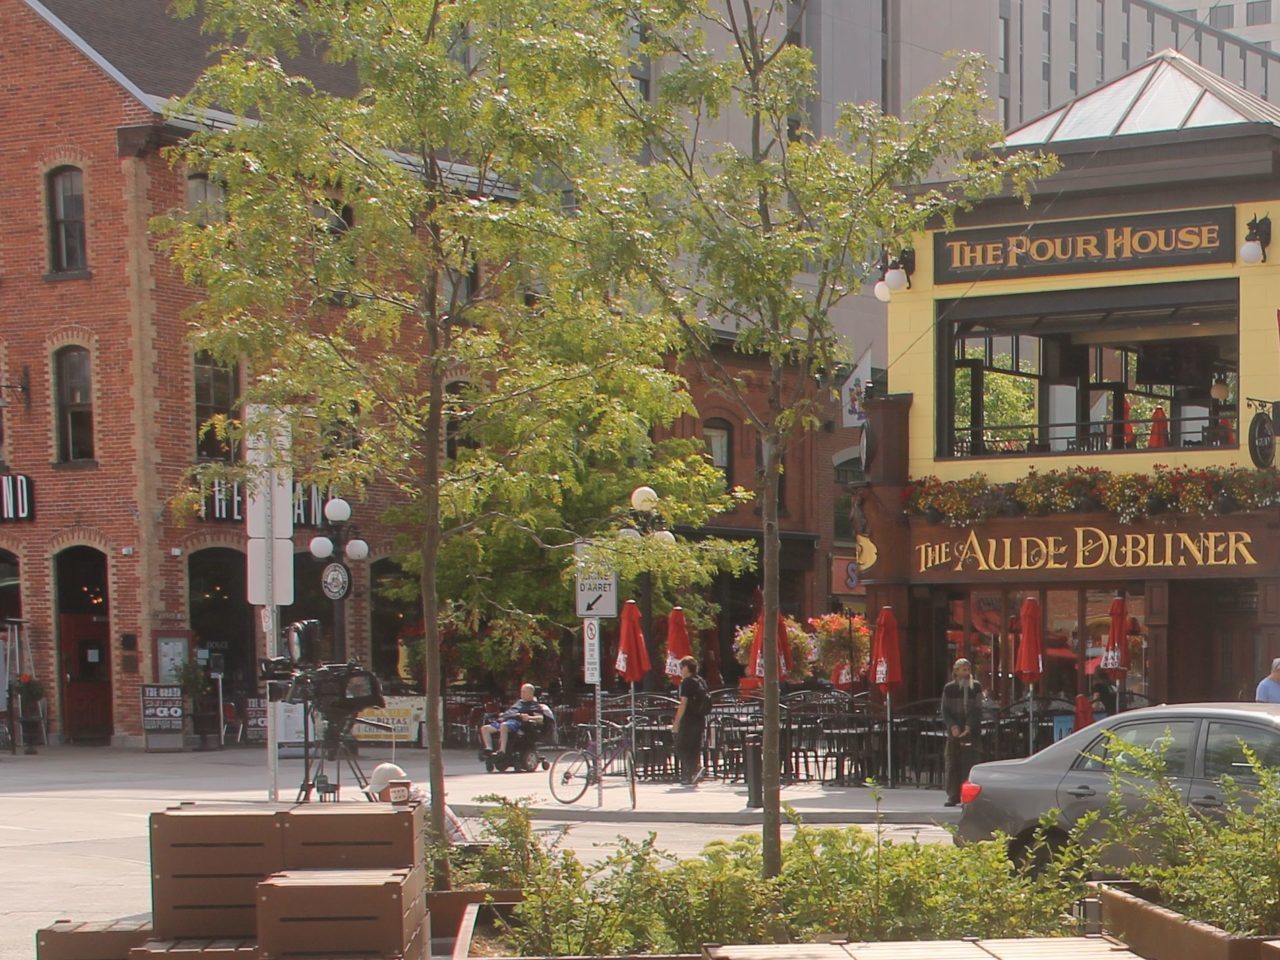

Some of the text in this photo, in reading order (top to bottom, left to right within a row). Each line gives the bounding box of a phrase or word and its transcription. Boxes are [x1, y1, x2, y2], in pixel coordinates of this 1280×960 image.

[947, 223, 1220, 268] THE POUR HOUSE
[915, 526, 1258, 573] THE AULDE DUBLINER
